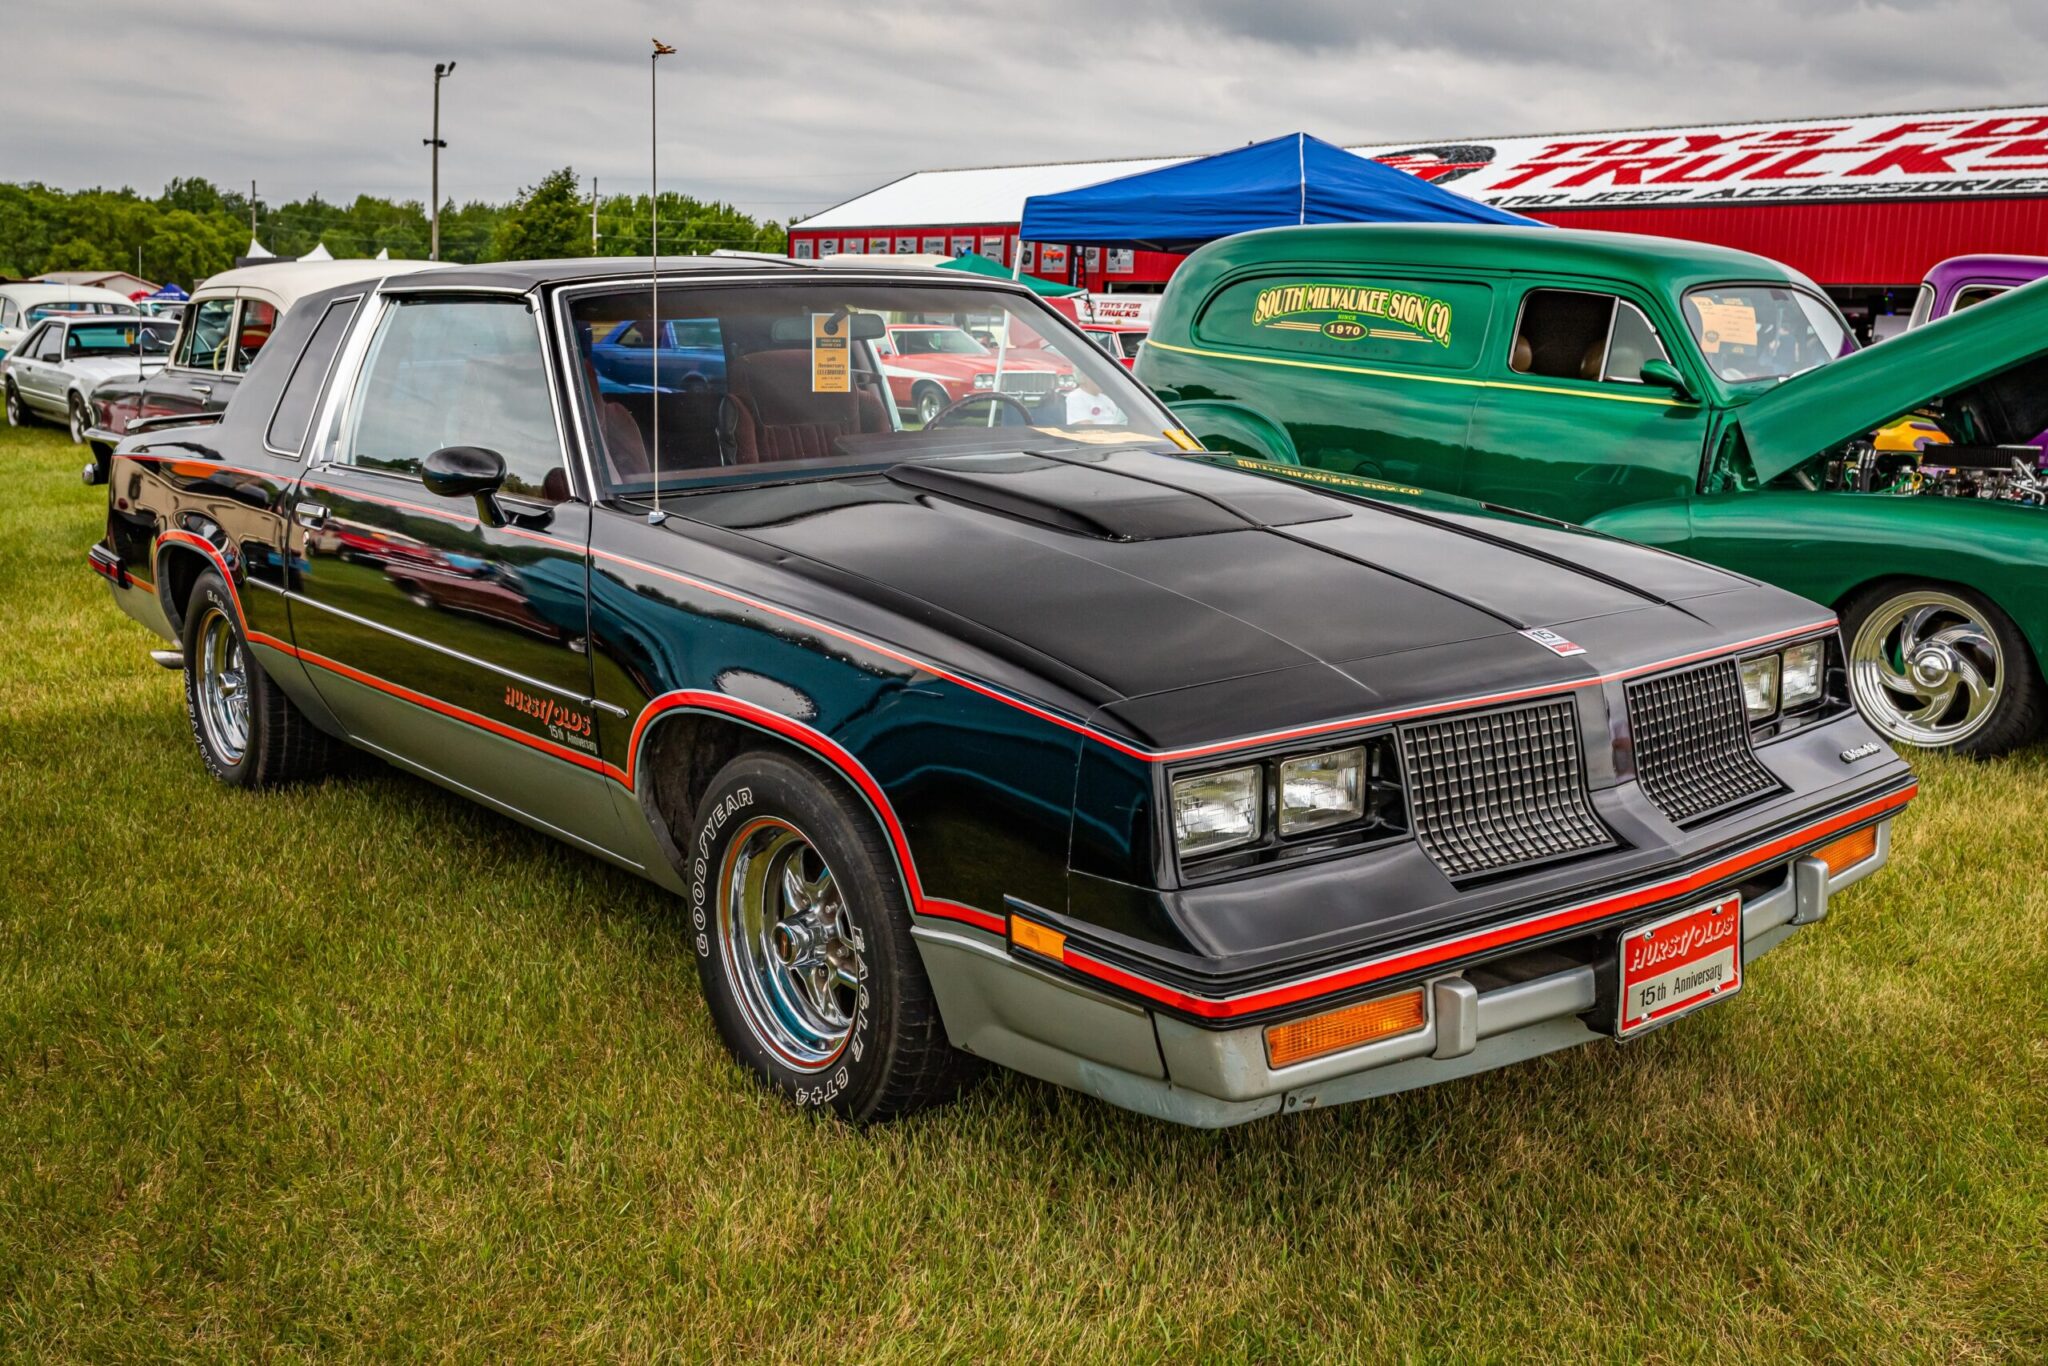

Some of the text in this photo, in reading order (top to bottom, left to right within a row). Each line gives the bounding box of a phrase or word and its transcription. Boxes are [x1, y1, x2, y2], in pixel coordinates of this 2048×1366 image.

[1483, 138, 2048, 191] TRUCKS
[1528, 126, 1853, 160] TOYS
[1569, 189, 1694, 203] JEEP
[1693, 177, 2048, 199] ACCESSORIE
[1254, 286, 1450, 343] SOUTH MILWAUKEE SIGN CO.
[1329, 324, 1360, 335] 1970
[549, 725, 598, 755] 15th Anniversary
[693, 787, 754, 958] GOODYEAR
[852, 925, 870, 1063] EAGLE
[1639, 963, 1723, 1008] 15th Anniversary
